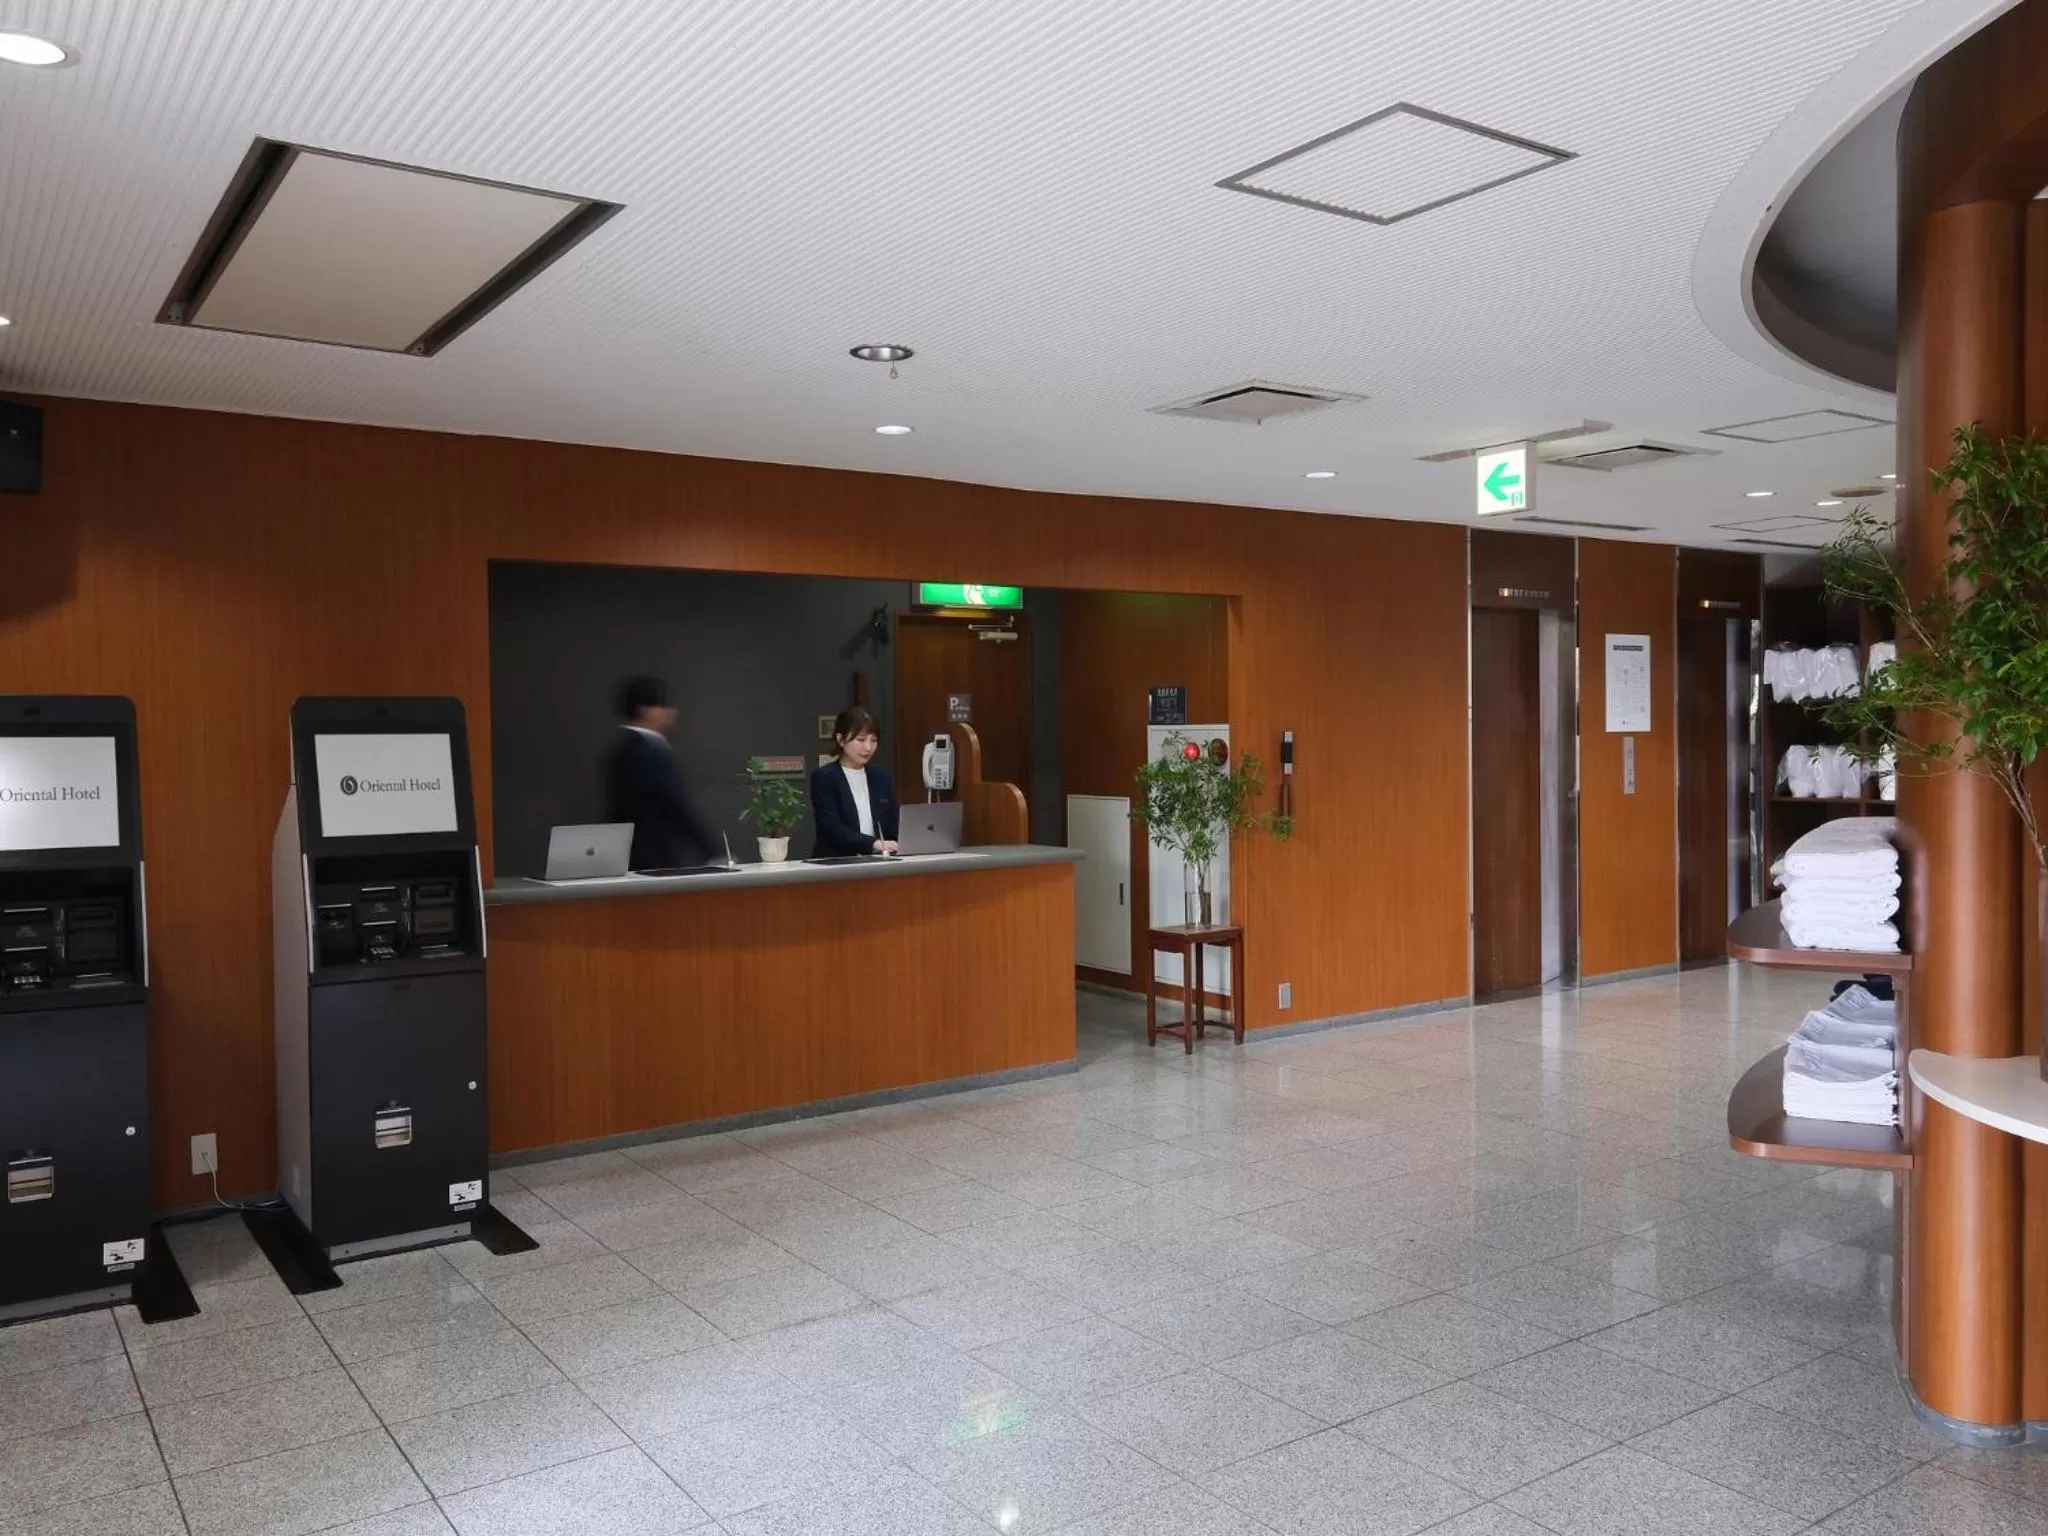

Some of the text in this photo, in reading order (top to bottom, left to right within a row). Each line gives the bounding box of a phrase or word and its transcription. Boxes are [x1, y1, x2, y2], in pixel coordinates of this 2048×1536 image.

[360, 778, 441, 792] Oriental Hotel
[0, 785, 100, 801] Oriental Hotel
